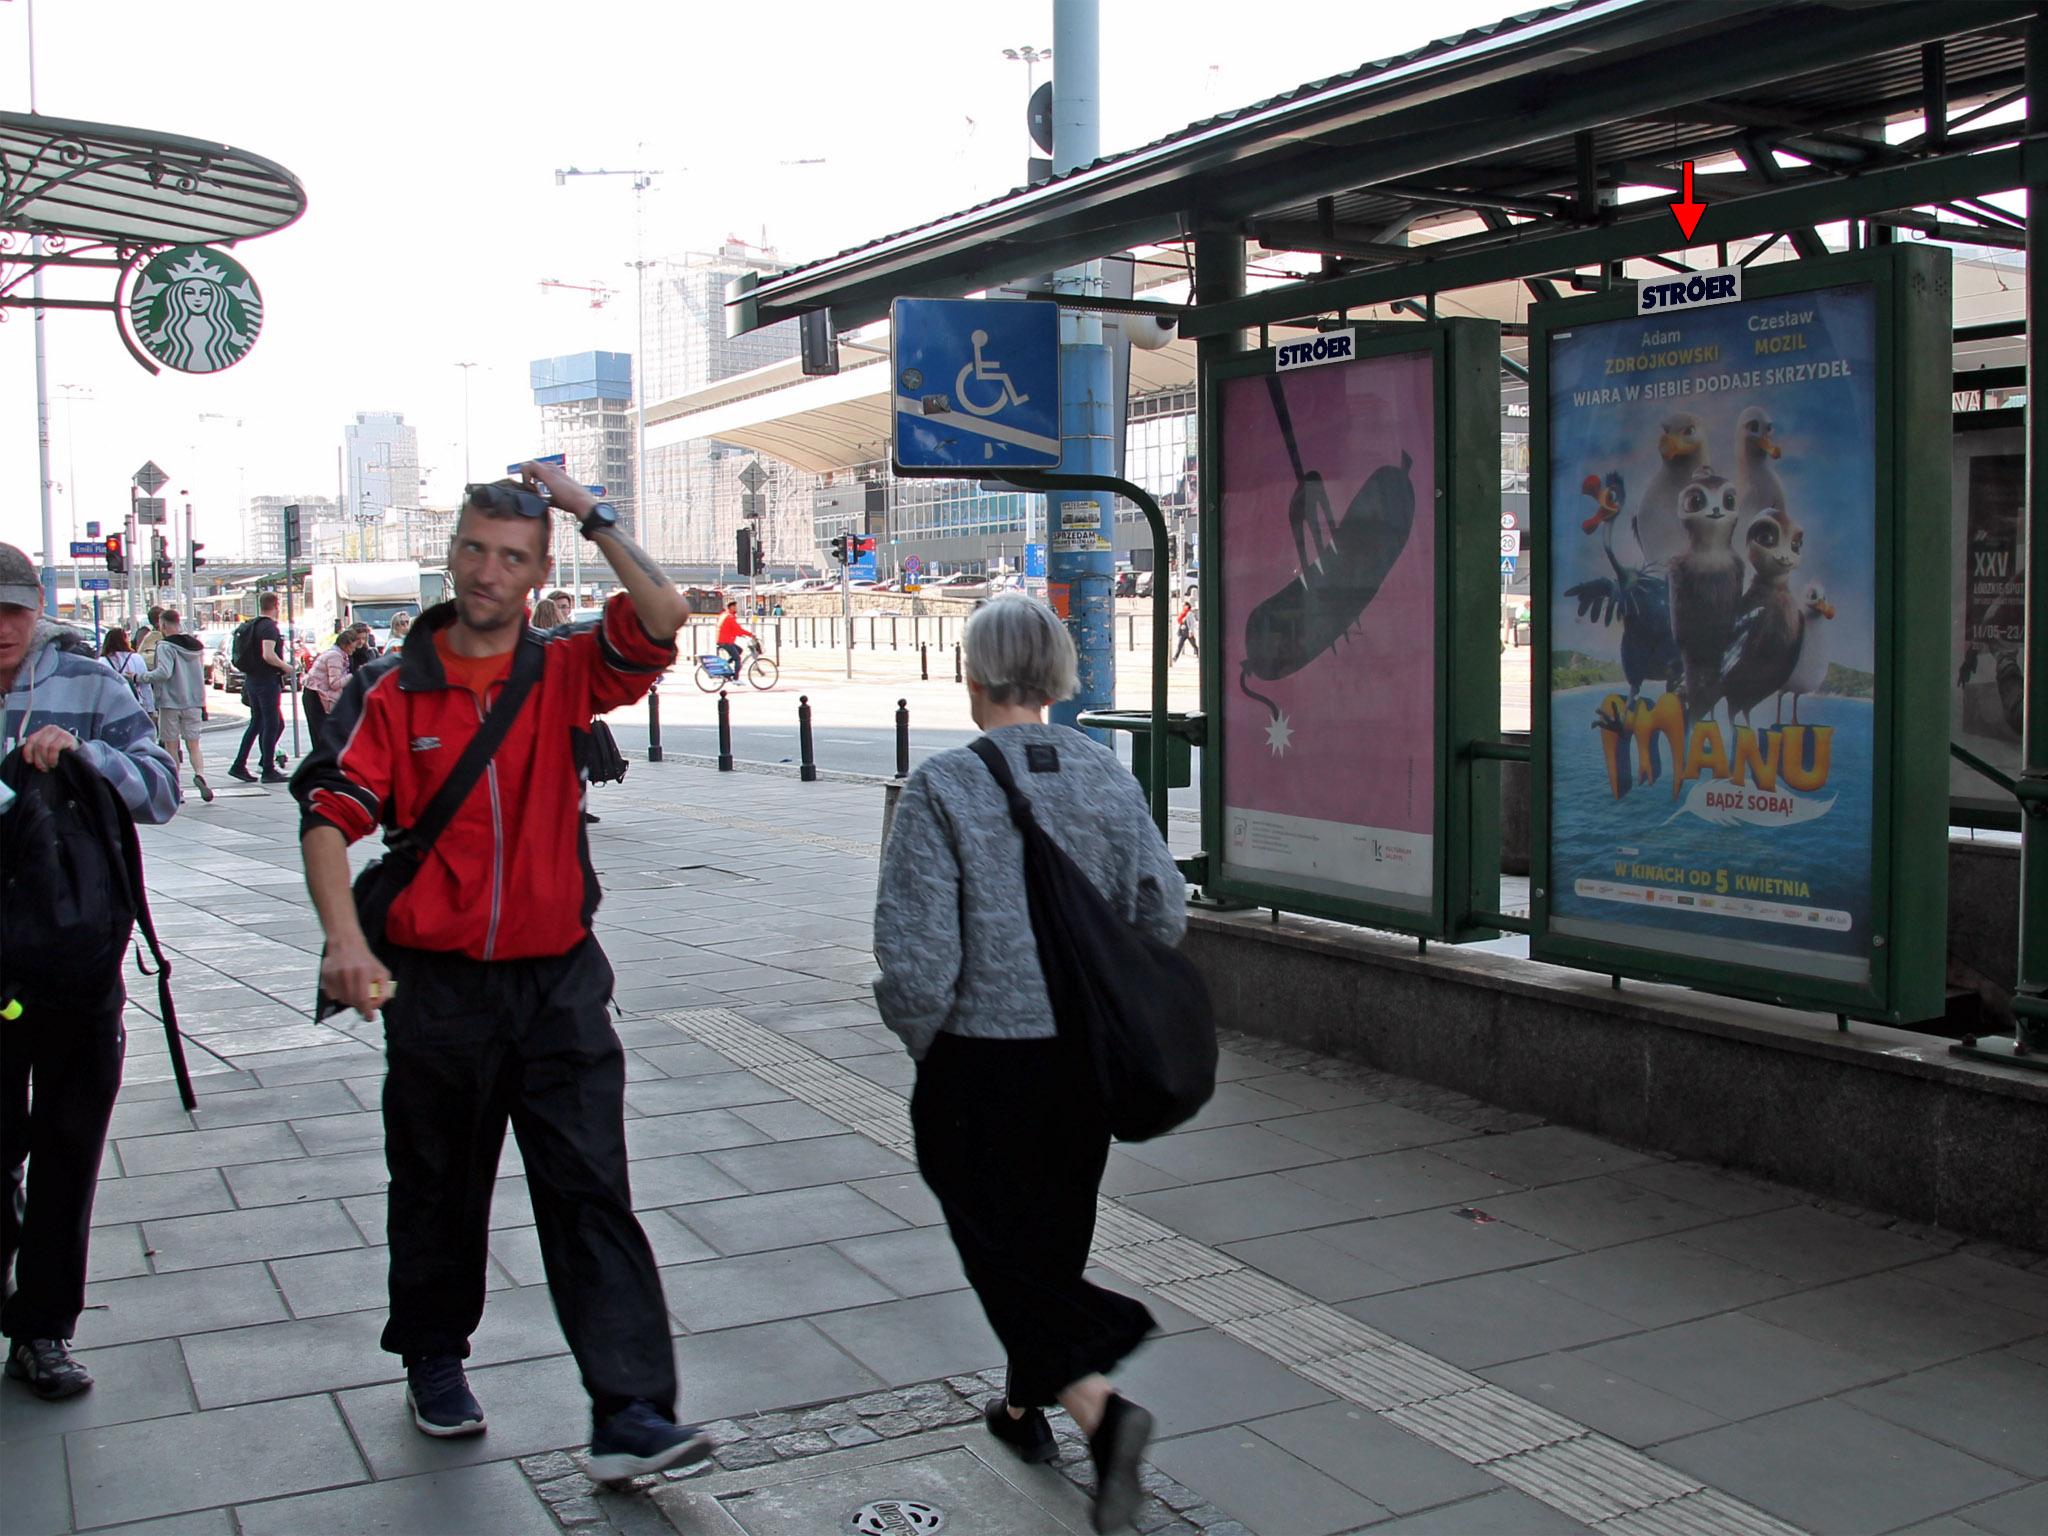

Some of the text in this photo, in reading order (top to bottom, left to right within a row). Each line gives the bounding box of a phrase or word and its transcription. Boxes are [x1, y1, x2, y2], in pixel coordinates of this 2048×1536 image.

[1642, 274, 1737, 309] STRÖER
[1748, 311, 1814, 332] Czesław
[1278, 336, 1352, 366] STRÖER
[1641, 329, 1681, 347] Adam
[1755, 334, 1807, 355] MOZIL
[1605, 345, 1719, 374] ZDRÓJKOWSKI
[1573, 360, 1852, 407] WIARA W SIEBIE DODAJE SKRZYDEŁ
[1054, 531, 1096, 540] SPRZEDAM
[1974, 552, 2009, 577] XXV
[1600, 692, 1835, 801] MANU
[1706, 791, 1794, 818] BĄDŹ SOBĄ!
[1615, 861, 1811, 898] W KINACH OD 5 KWIETNIA
